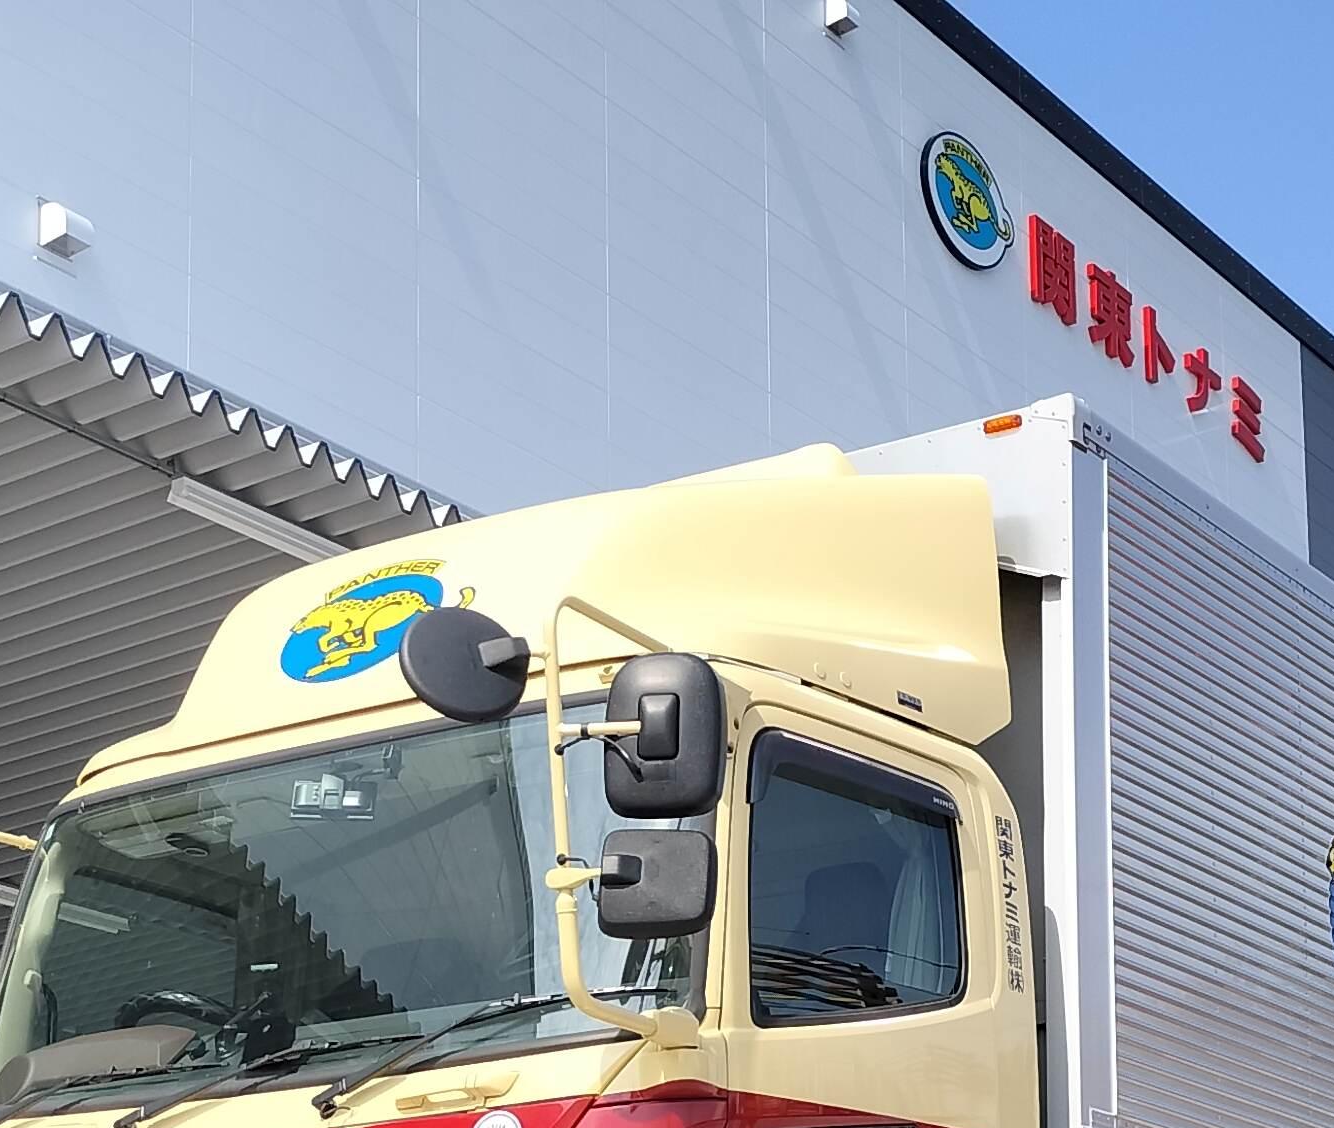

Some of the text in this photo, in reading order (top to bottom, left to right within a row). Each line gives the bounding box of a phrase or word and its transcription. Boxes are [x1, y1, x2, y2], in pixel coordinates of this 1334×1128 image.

[1028, 214, 1265, 463] 関東トナミ
[328, 561, 442, 600] PANTHER
[932, 796, 955, 810] HINO
